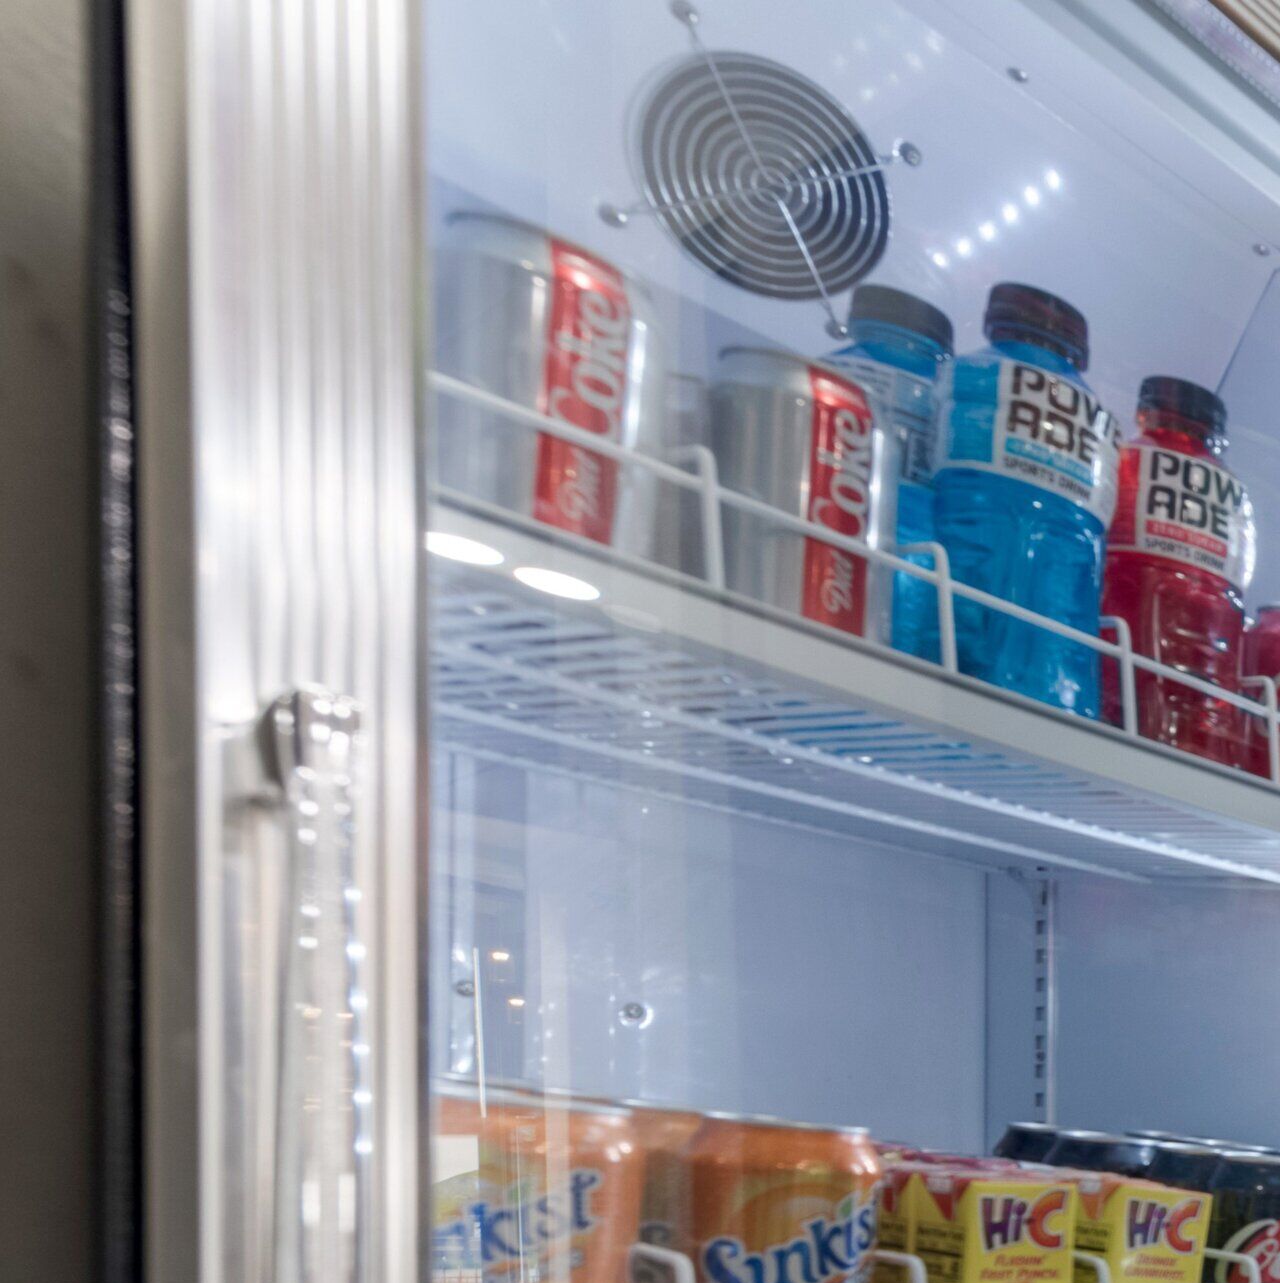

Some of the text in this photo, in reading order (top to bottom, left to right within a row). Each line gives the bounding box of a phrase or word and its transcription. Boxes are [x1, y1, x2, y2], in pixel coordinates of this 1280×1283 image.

[551, 290, 627, 443] Coke
[1007, 400, 1094, 464] ADE
[811, 409, 871, 545] Coke
[1147, 485, 1229, 540] ADE
[978, 1186, 1070, 1252] Hi-C
[1128, 1196, 1203, 1255] Hi-C
